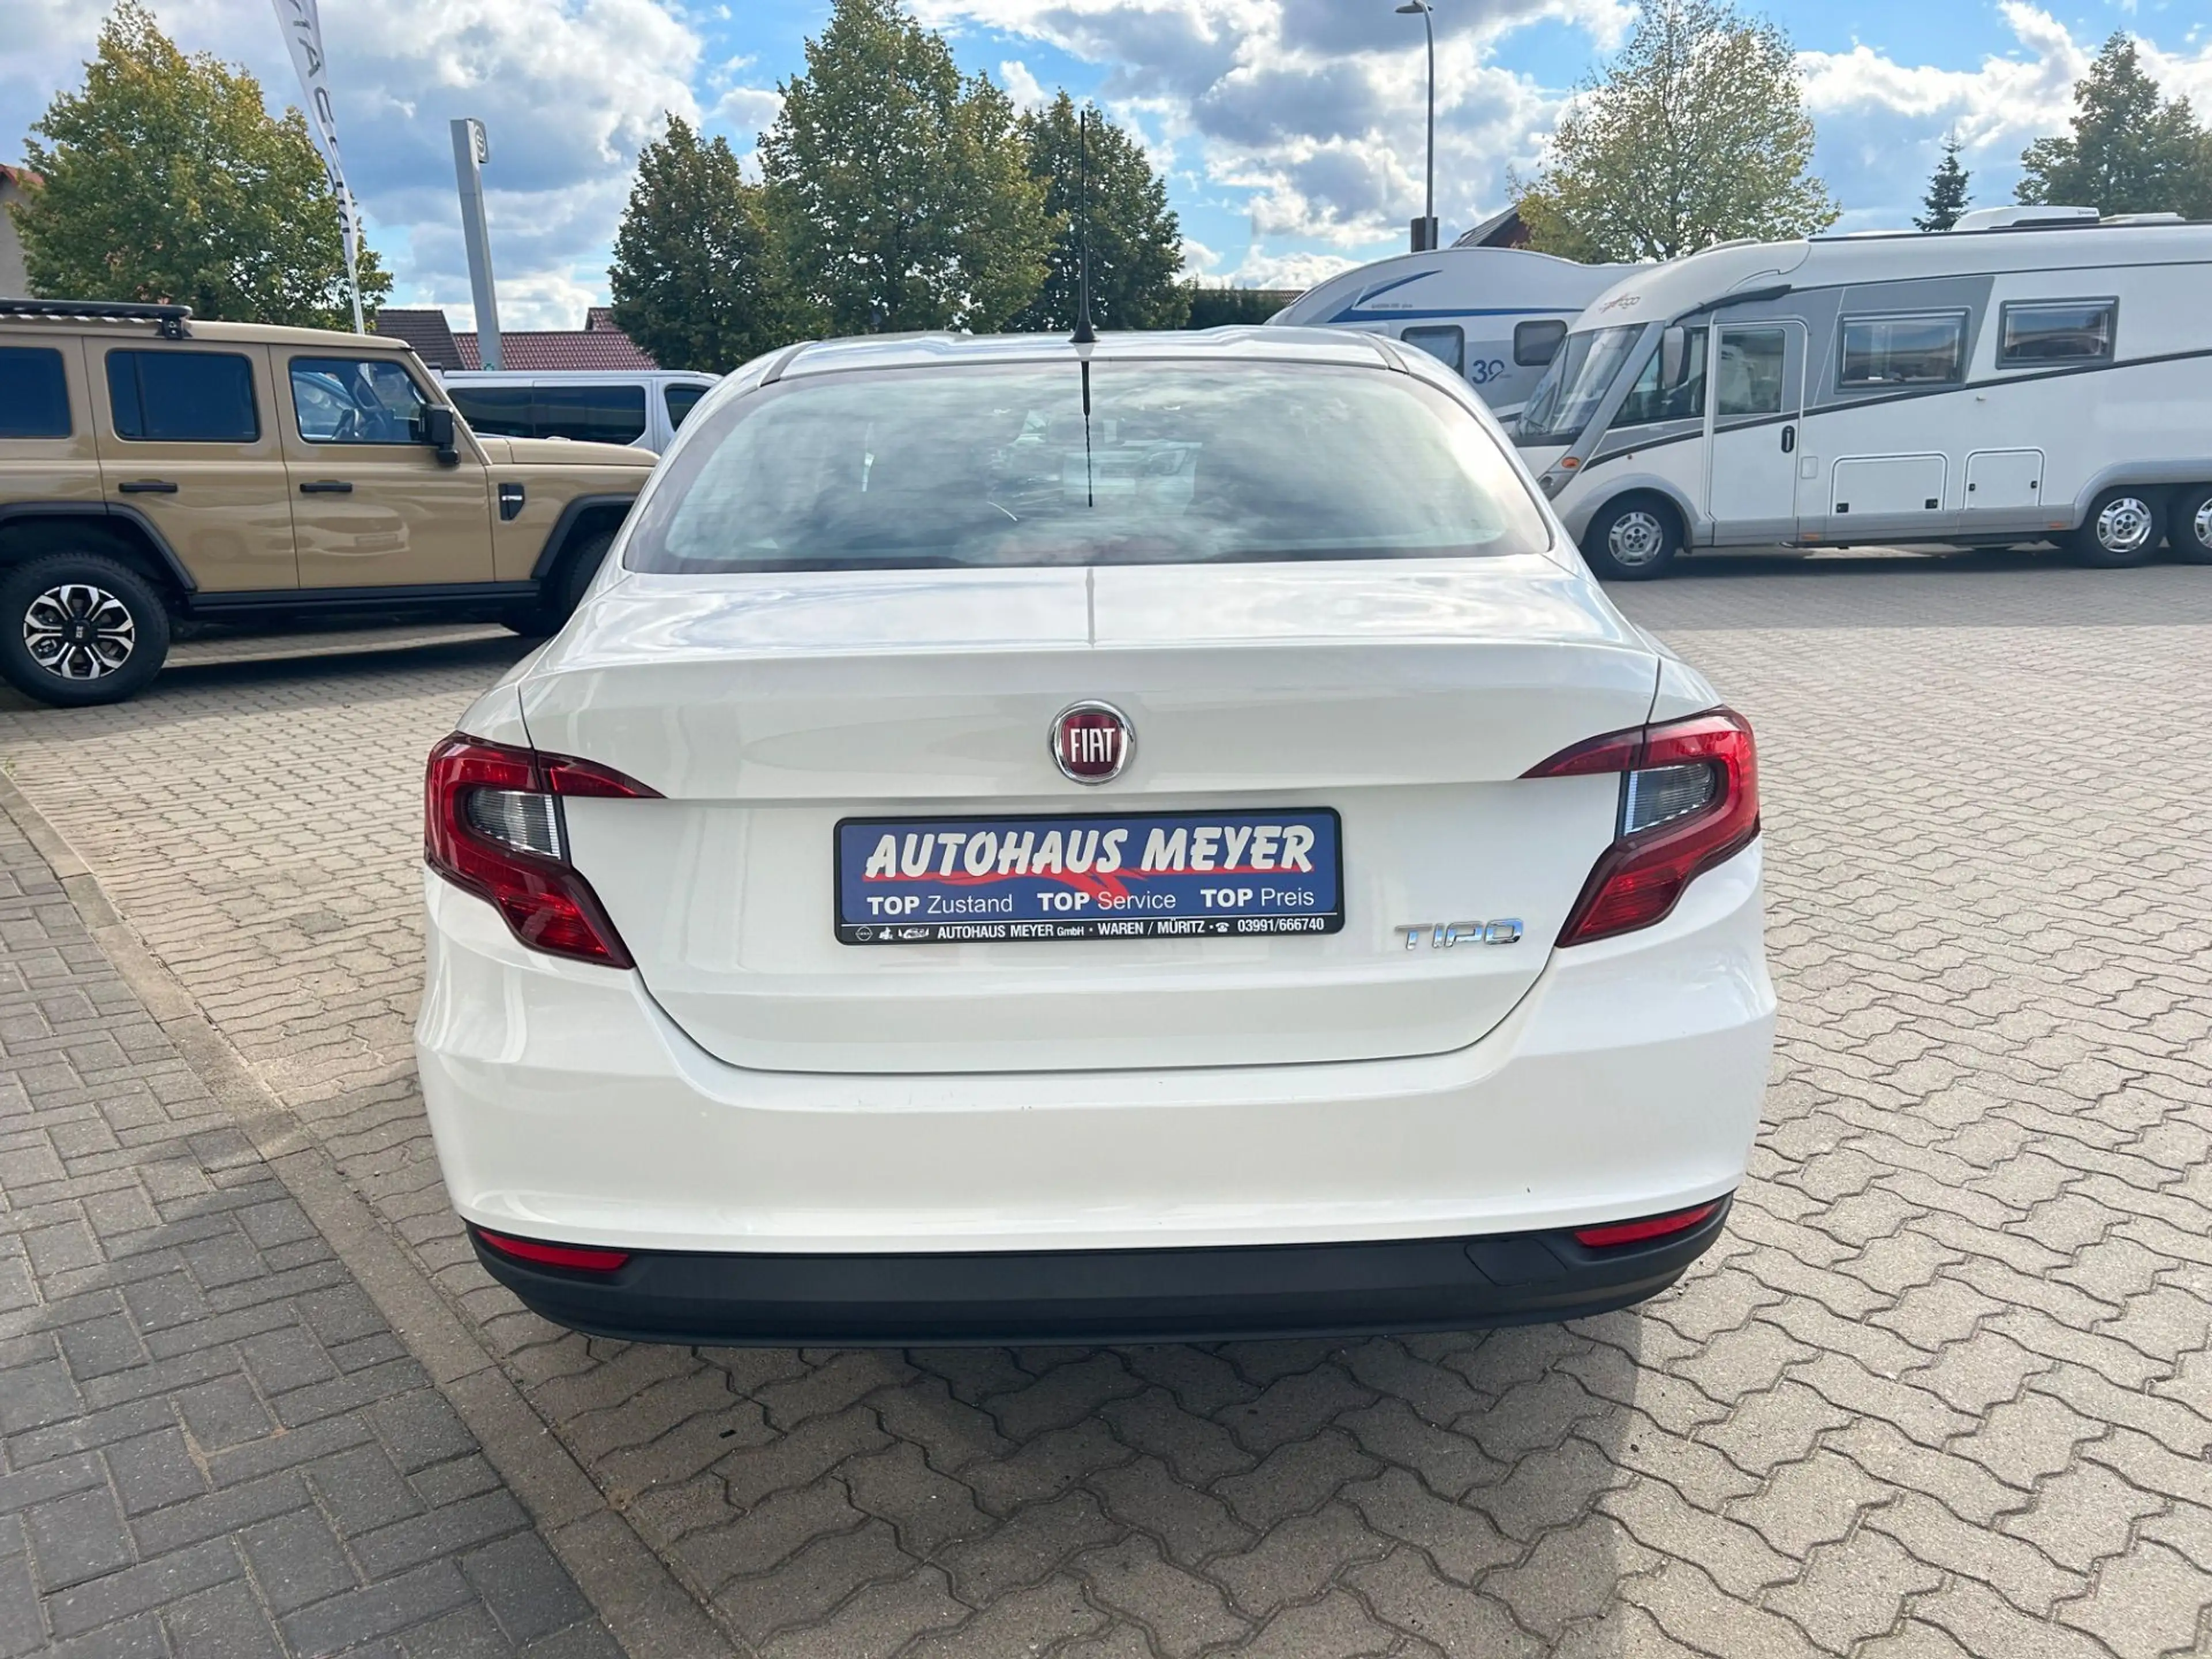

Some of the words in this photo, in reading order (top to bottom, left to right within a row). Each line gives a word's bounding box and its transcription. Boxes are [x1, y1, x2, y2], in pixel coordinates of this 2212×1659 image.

[1070, 728, 1116, 763] FIAT
[865, 828, 1129, 878] AUTOHAUS
[1140, 825, 1315, 873] MEYER
[867, 896, 921, 915] TOP
[927, 893, 1013, 914] Zustand
[1037, 892, 1090, 911] TOP
[1097, 891, 1176, 910] Service
[1200, 888, 1254, 908] TOP
[1260, 887, 1315, 907] Preis
[937, 925, 1006, 940] AUTOHAUS
[1010, 923, 1054, 938] MEYER
[1056, 926, 1085, 937] GmbH
[1097, 922, 1144, 935] WAREN
[1157, 918, 1206, 934] MÜRITZ
[1237, 918, 1324, 932] 03991/666740
[1394, 918, 1524, 952] TIPO
